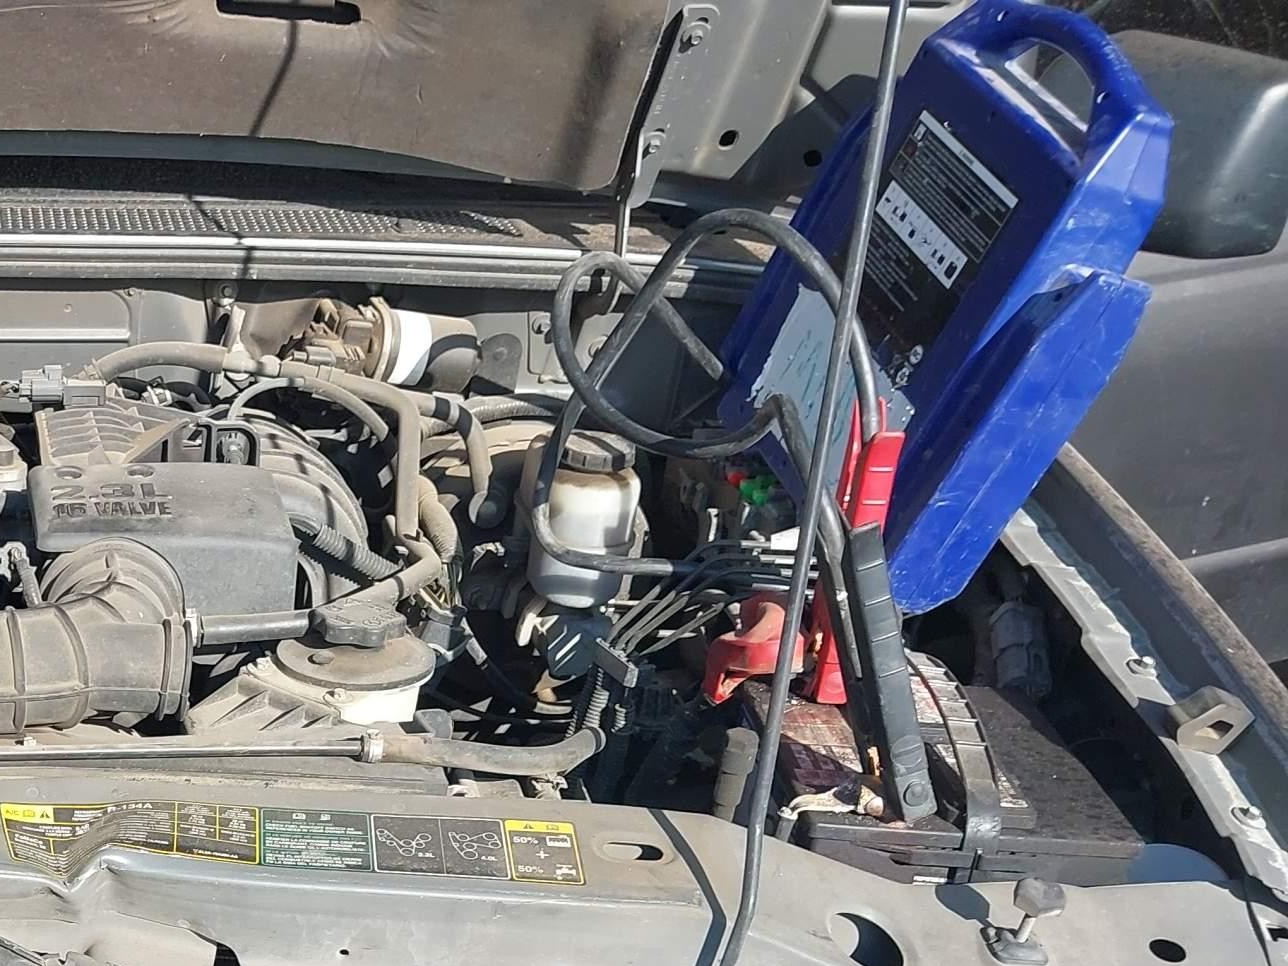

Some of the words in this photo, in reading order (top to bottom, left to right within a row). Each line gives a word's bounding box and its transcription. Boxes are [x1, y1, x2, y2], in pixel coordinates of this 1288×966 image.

[51, 483, 173, 501] 2.3L
[52, 502, 88, 518] 16
[94, 501, 173, 516] VALVE
[106, 802, 153, 814] R-134A
[512, 836, 540, 845] 50%
[517, 865, 544, 874] 50%
